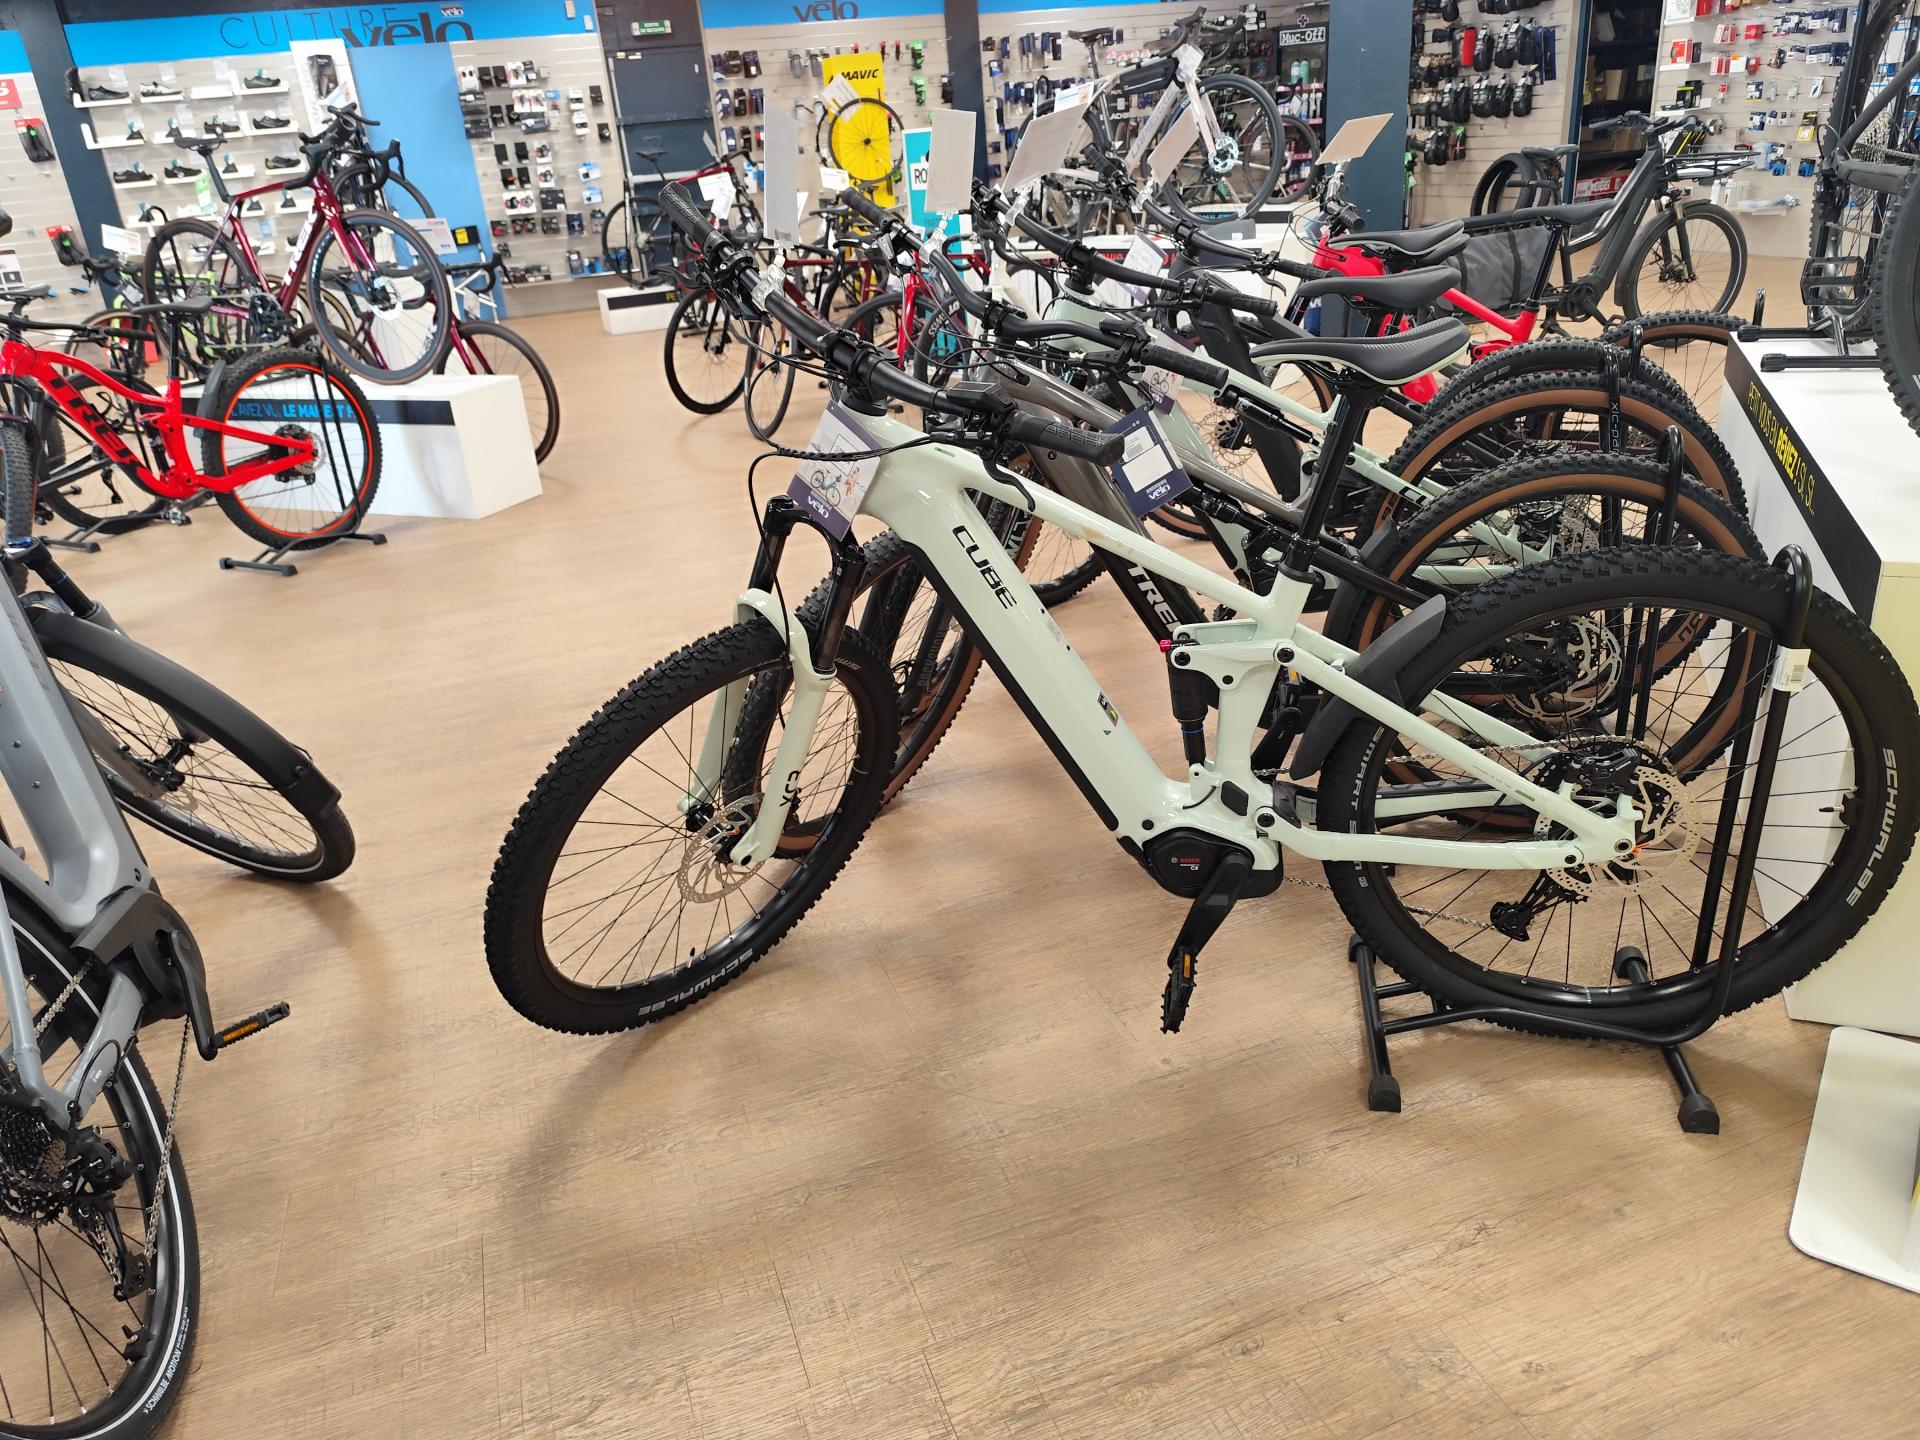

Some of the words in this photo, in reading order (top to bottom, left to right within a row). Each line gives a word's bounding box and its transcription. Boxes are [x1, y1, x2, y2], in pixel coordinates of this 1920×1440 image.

[1281, 29, 1323, 43] Muc-Off
[841, 68, 879, 81] MAVIC
[953, 525, 1018, 609] CUBE
[1351, 725, 1385, 811] SMART
[1846, 748, 1899, 907] SCHWALBE
[638, 948, 753, 1016] SCHWALBE
